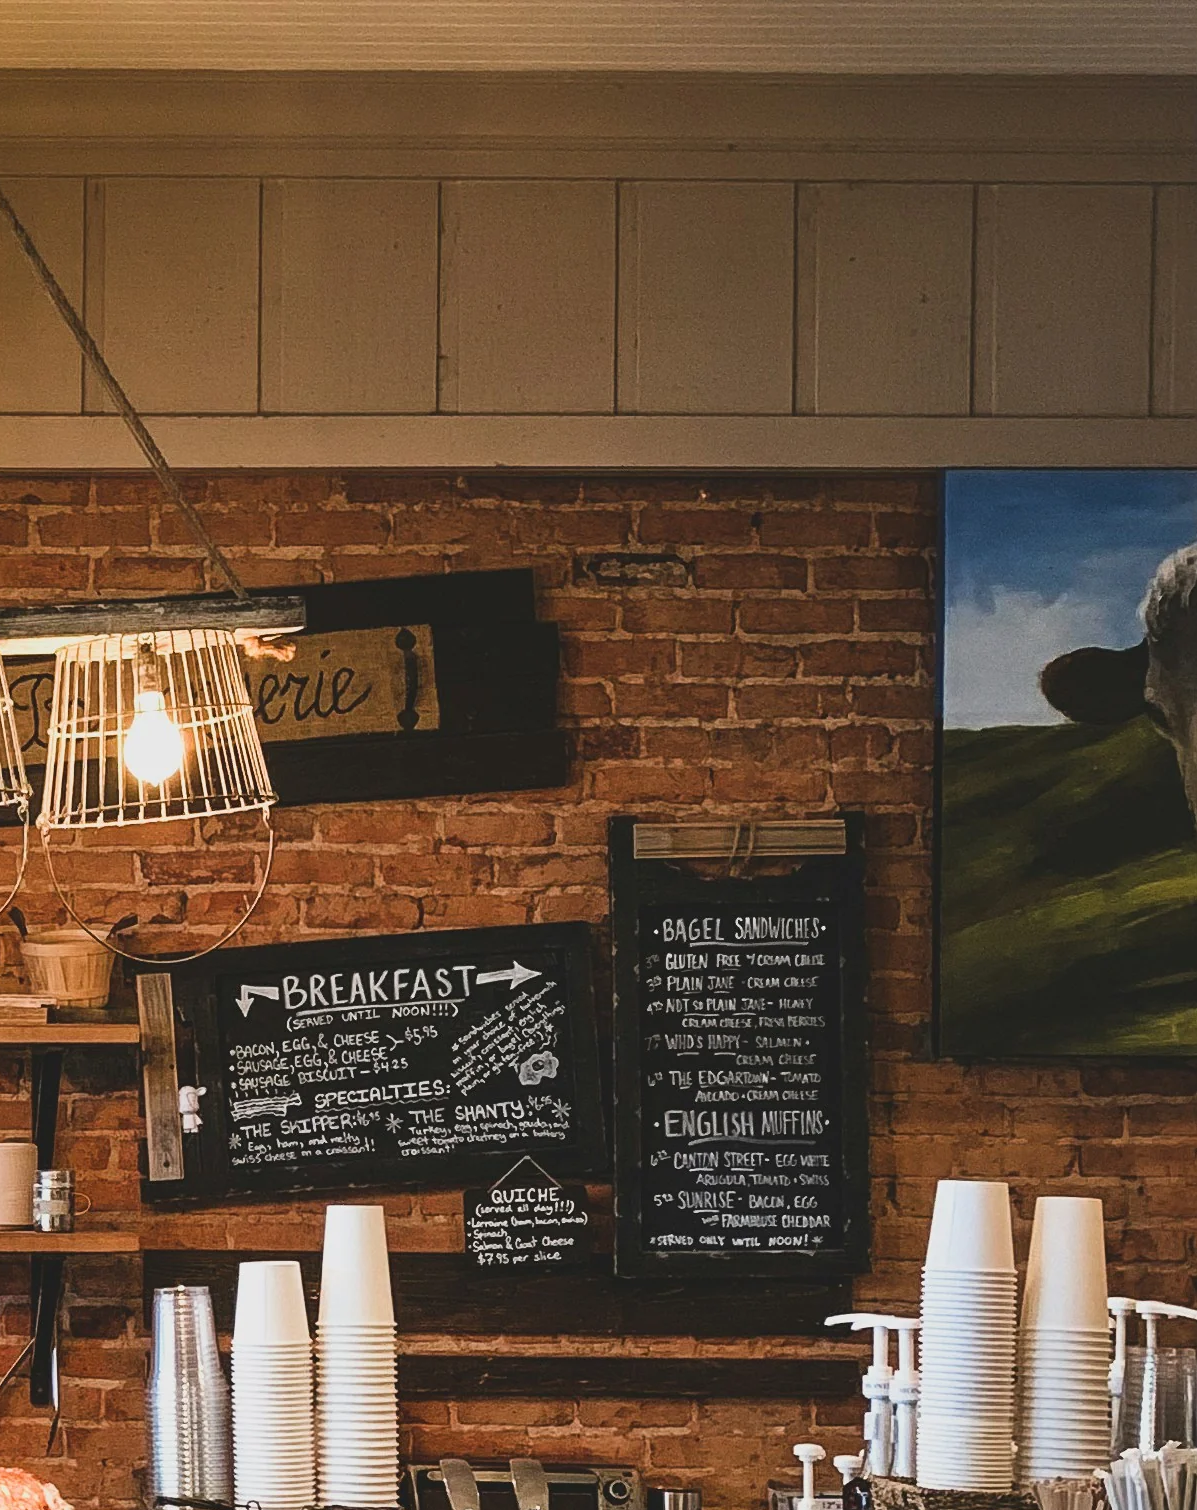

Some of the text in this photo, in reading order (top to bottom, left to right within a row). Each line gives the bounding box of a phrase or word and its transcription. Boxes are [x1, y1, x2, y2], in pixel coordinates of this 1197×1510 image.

[662, 916, 820, 942] BAGEL SANDWICHES
[665, 952, 708, 970] GLUTEN
[716, 953, 742, 968] FREE
[757, 953, 791, 967] CREAM
[282, 964, 478, 1010] BREAKFAST
[667, 975, 703, 992] PLAIN
[707, 975, 735, 990] JANE
[747, 976, 780, 989] CREAM
[665, 998, 688, 1013] NOT
[706, 998, 736, 1012] PLAIN
[286, 1002, 459, 1033] (SERVED UNTIL NOON!!!)
[681, 1018, 717, 1028] CREAM
[317, 1033, 328, 1049] &
[333, 1030, 380, 1047] CHEESE
[404, 1025, 438, 1046] $5.95
[328, 1049, 338, 1065] &
[342, 1046, 389, 1065] CHEESE
[735, 1054, 774, 1066] CREAM
[239, 1074, 292, 1091] SAUSAGE
[298, 1066, 358, 1085] BISCUIT
[668, 1070, 693, 1087] THE
[314, 1079, 451, 1109] SPECIALTIES:
[747, 1090, 780, 1102] CREAM
[408, 1107, 445, 1125] THE
[664, 1109, 824, 1138] ENGLISH MUFFINS
[239, 1122, 272, 1139] THE
[308, 1134, 328, 1146] and
[231, 1152, 262, 1166] swiss
[264, 1151, 298, 1162] cheese
[315, 1148, 322, 1156] a
[775, 1153, 798, 1168] EGG
[491, 1186, 560, 1204] QUICHE
[677, 1190, 737, 1210] SUNRISE
[794, 1195, 818, 1209] EGG
[475, 1203, 513, 1218] (served
[517, 1203, 530, 1213] all
[781, 1213, 832, 1229] CHEDDAR
[473, 1228, 508, 1240] Spinach
[472, 1240, 504, 1253] Salmon
[505, 1235, 514, 1251] &
[541, 1235, 575, 1247] Cheese
[512, 1253, 530, 1265] per
[533, 1250, 563, 1263] slice
